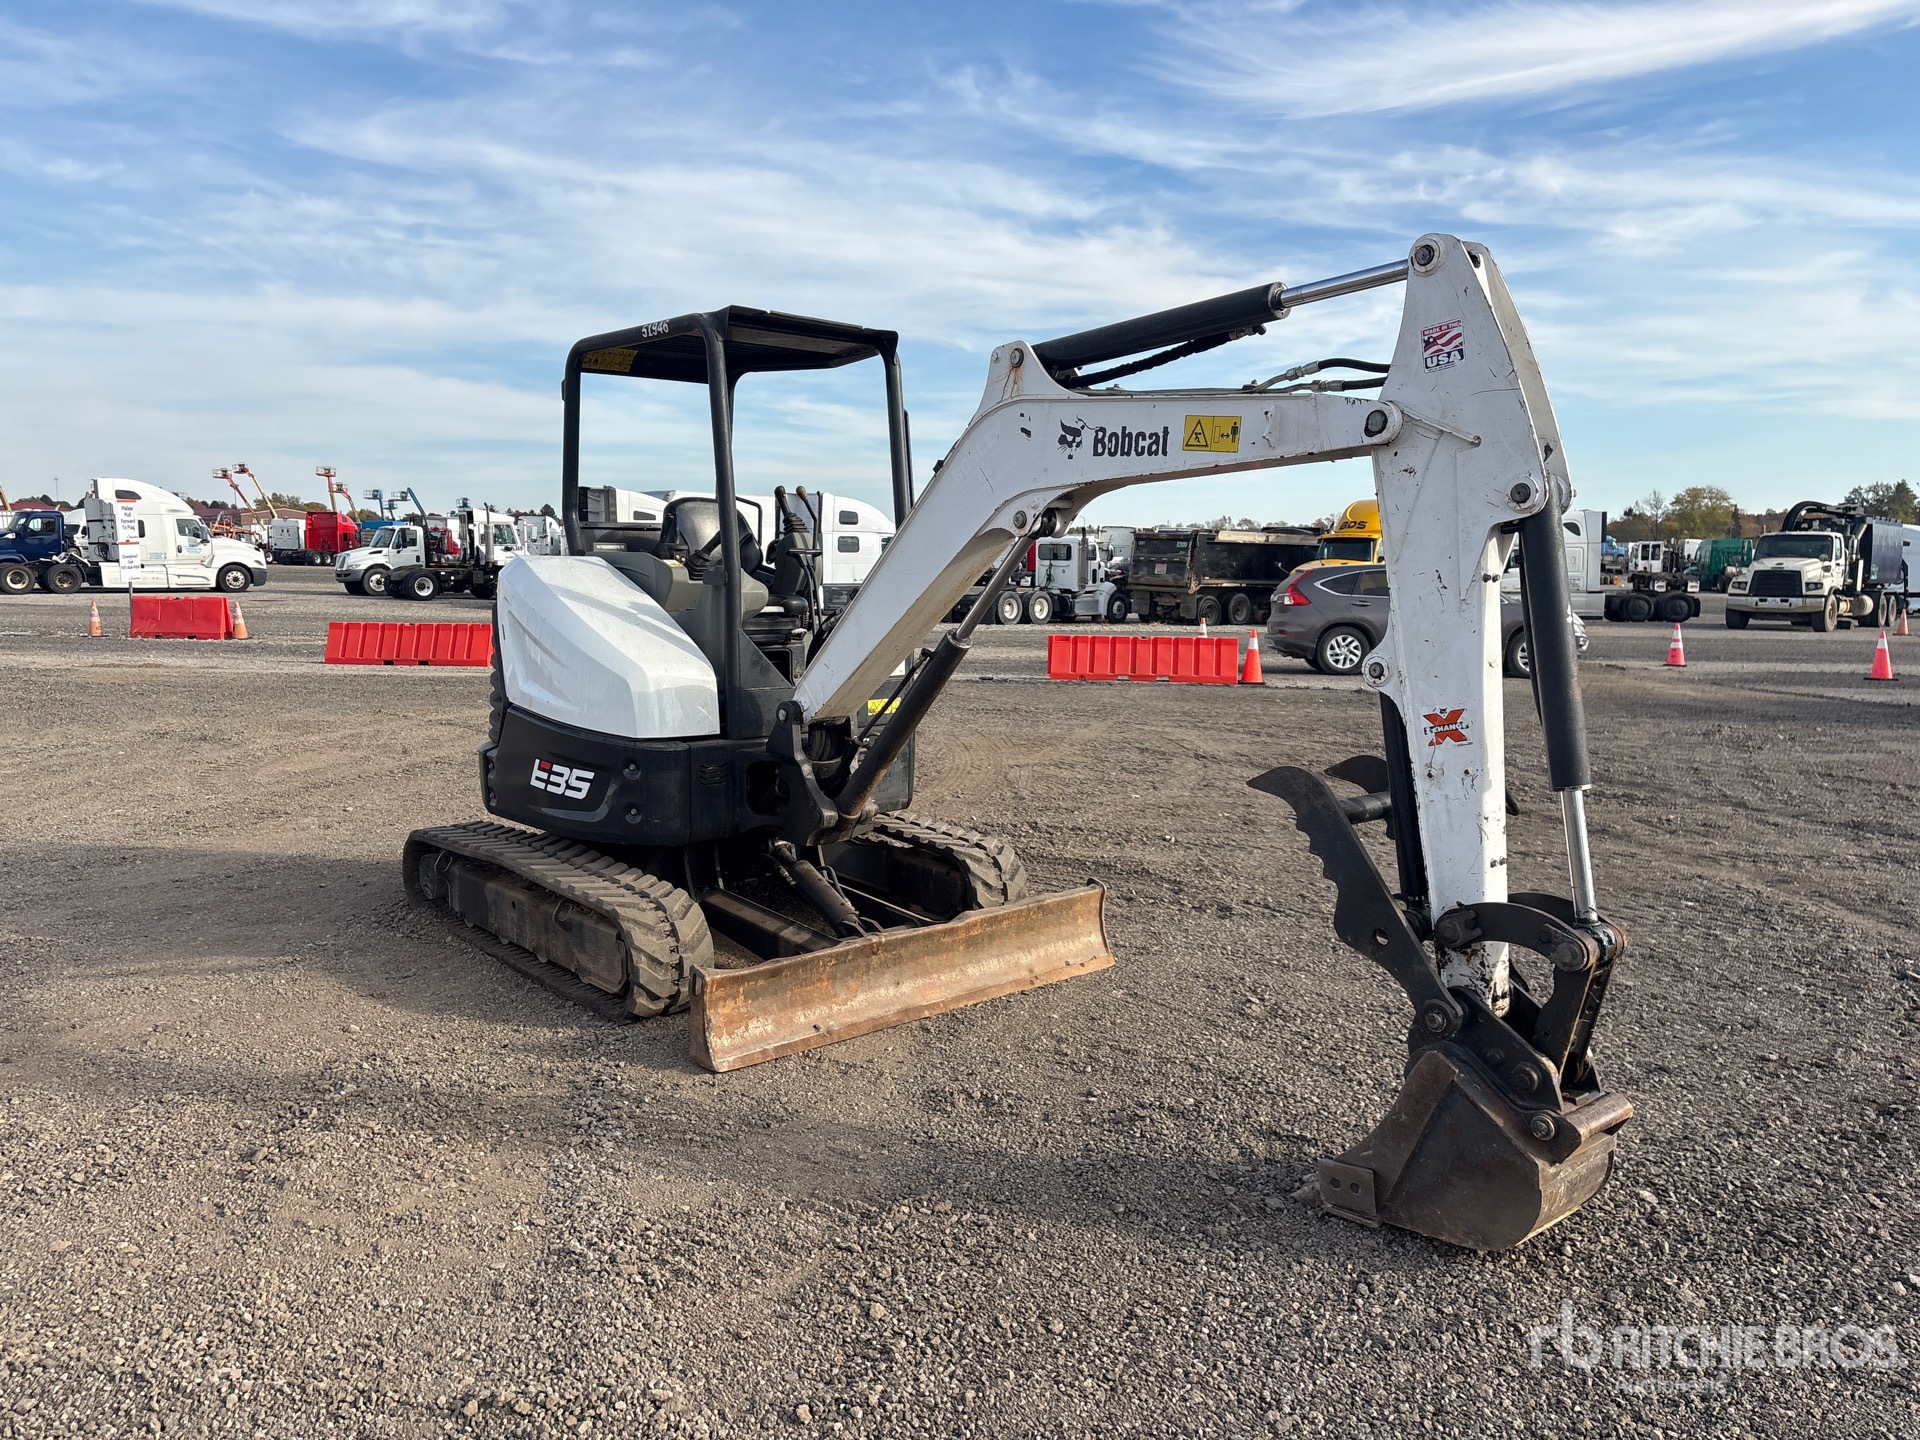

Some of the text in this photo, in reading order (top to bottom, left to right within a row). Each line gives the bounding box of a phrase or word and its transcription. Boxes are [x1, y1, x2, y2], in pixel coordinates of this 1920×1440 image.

[641, 320, 669, 338] 51946
[1424, 327, 1440, 335] MADE
[1426, 351, 1461, 367] USA
[1092, 426, 1169, 457] Bobcat
[529, 758, 595, 800] E35
